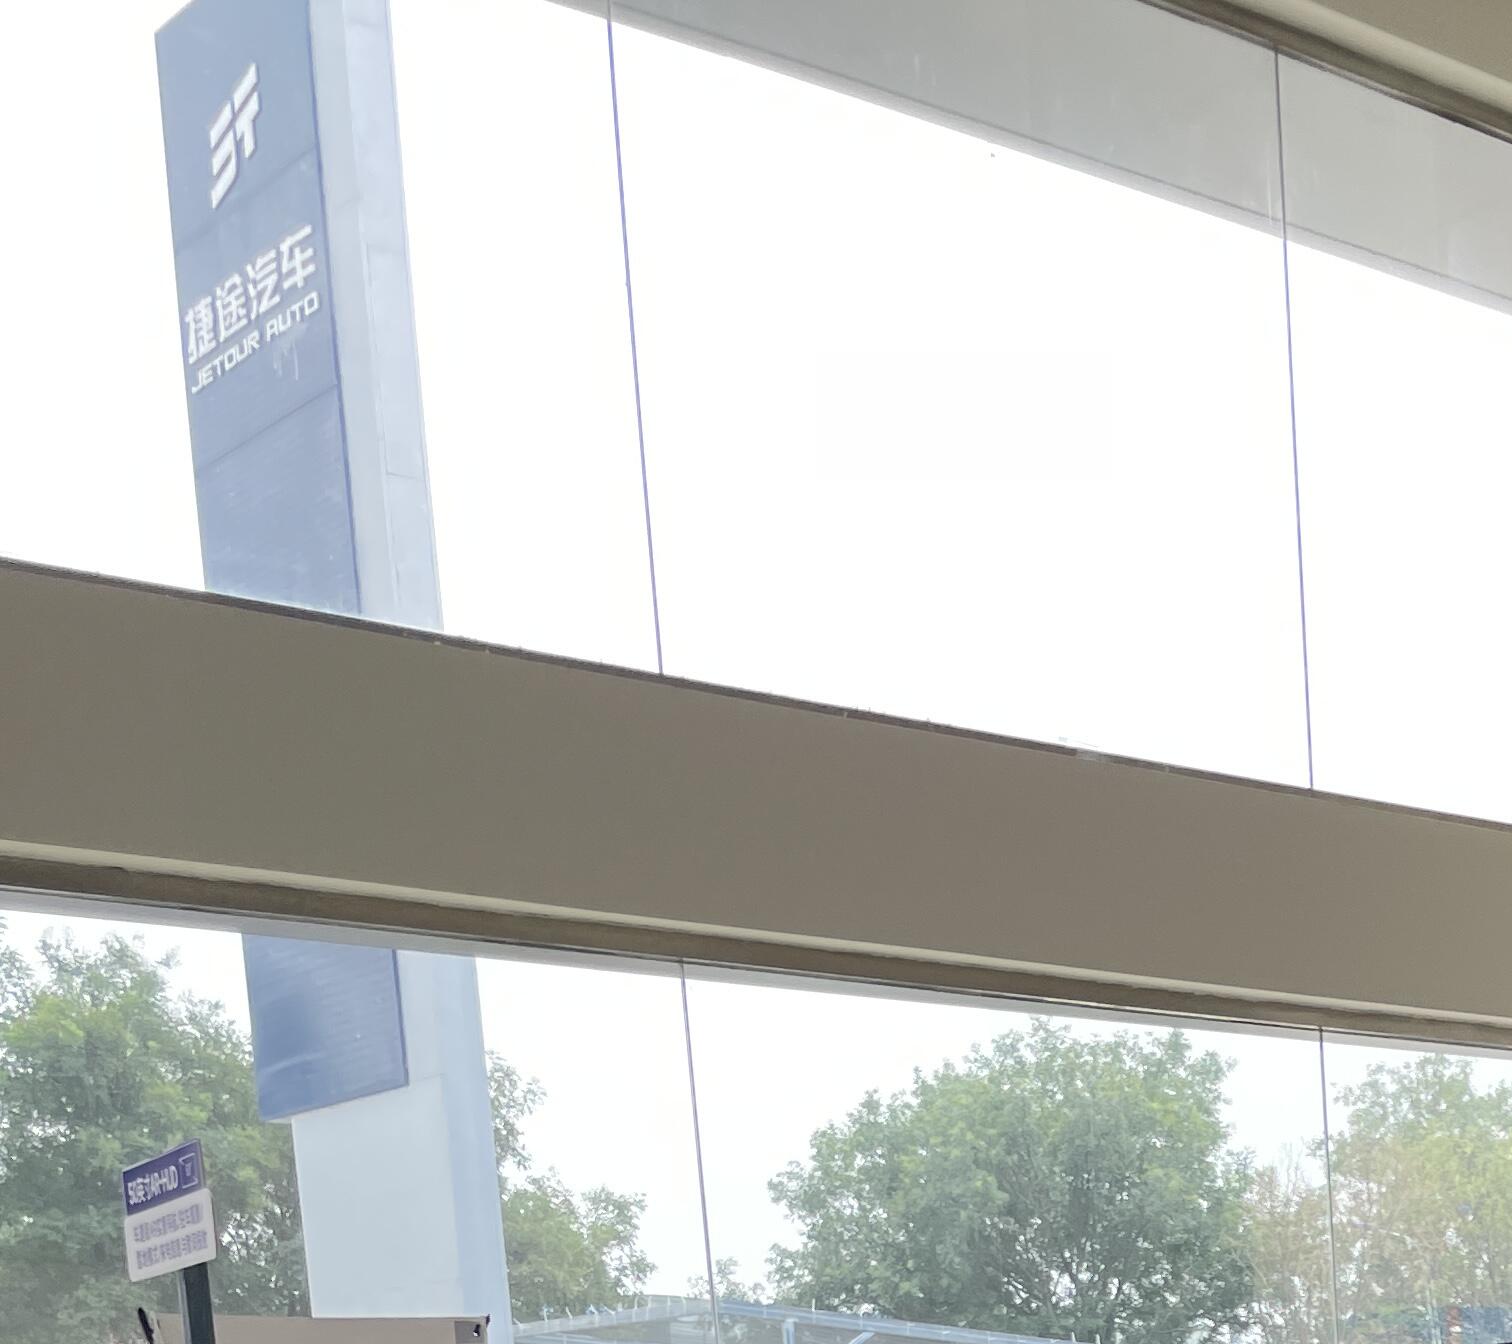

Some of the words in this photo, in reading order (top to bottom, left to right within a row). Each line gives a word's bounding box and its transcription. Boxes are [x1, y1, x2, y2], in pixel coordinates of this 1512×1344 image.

[184, 224, 316, 364] 捷途汽车
[191, 331, 261, 394] JETOUR
[266, 291, 320, 342] AUTO
